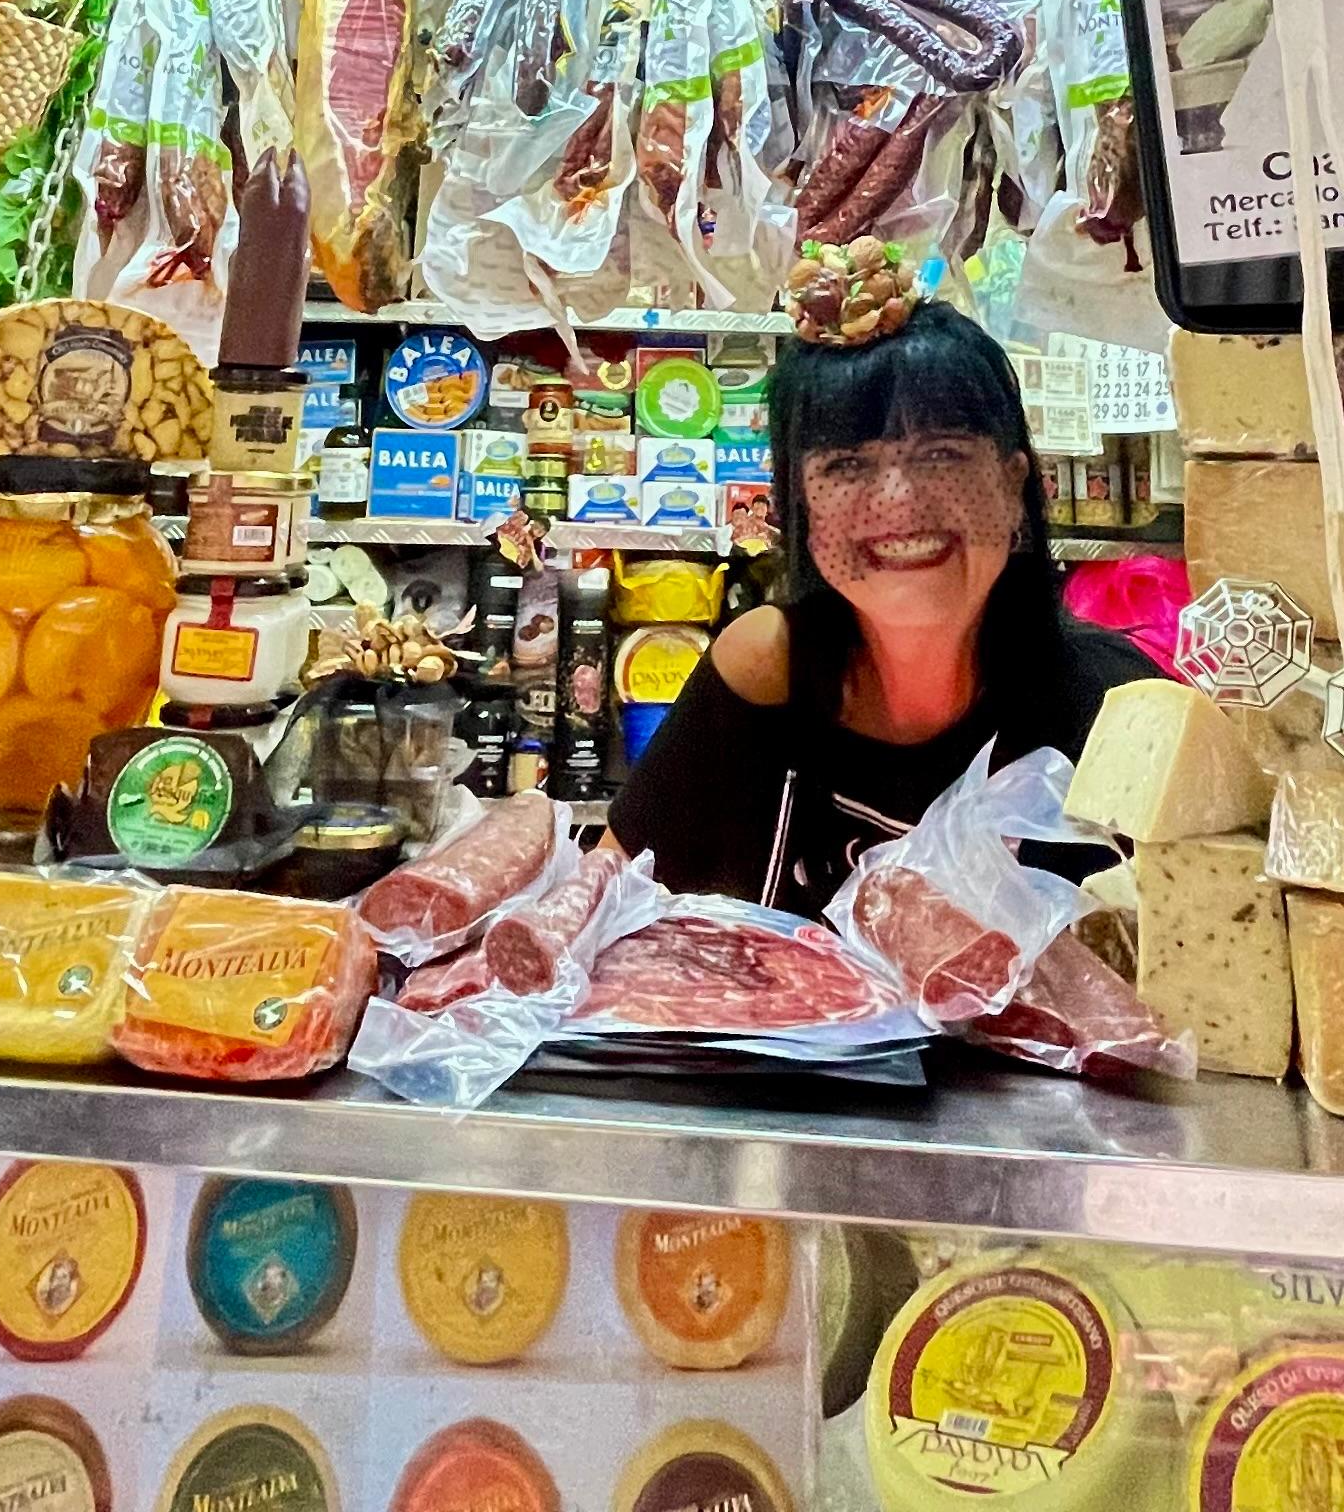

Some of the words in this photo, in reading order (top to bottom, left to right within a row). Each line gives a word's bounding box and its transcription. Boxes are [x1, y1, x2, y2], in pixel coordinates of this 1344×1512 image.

[388, 336, 474, 383] BALEA
[1096, 363, 1110, 378] 15
[1116, 362, 1130, 378] 16
[1136, 360, 1150, 377] 17
[306, 387, 341, 408] ALE
[1093, 383, 1110, 399] 22
[1113, 383, 1130, 399] 23
[1134, 382, 1150, 398] 24
[1093, 403, 1110, 419] 29
[1112, 403, 1130, 419] 30
[377, 450, 448, 470] BALEA
[716, 447, 773, 463] BALEA
[475, 481, 521, 498] BALEA
[632, 670, 689, 692] PAYOY
[156, 947, 312, 982] MONTEALVA
